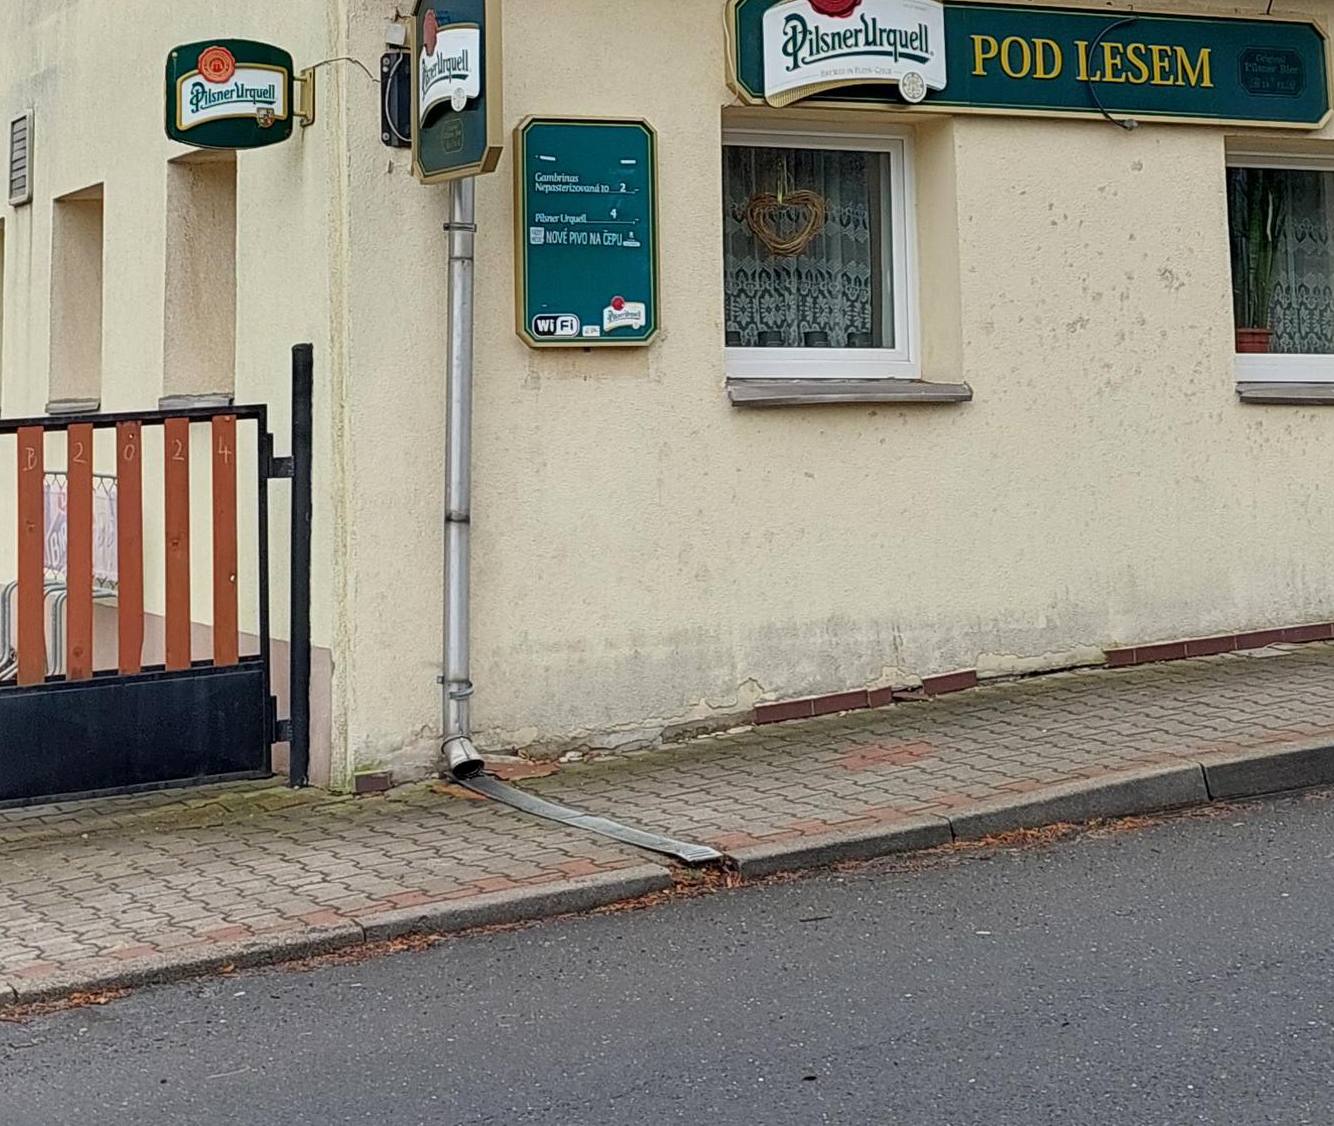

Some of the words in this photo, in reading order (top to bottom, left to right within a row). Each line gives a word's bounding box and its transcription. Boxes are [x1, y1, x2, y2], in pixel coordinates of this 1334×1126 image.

[781, 13, 863, 72] Pilsner
[860, 13, 929, 63] Urquell
[437, 48, 469, 83] Urquell
[970, 34, 1063, 80] POD
[1074, 40, 1214, 88] LESEM
[189, 81, 235, 113] Pilsner
[234, 81, 275, 105] Urquell
[535, 172, 579, 183] Gambrinus
[535, 213, 559, 223] Pilsner
[560, 213, 587, 225] Urquell
[610, 208, 618, 219] 4
[546, 227, 567, 244] NOVÉ
[569, 231, 588, 245] PIVO
[589, 232, 602, 245] NA
[603, 229, 623, 246] ČEPU
